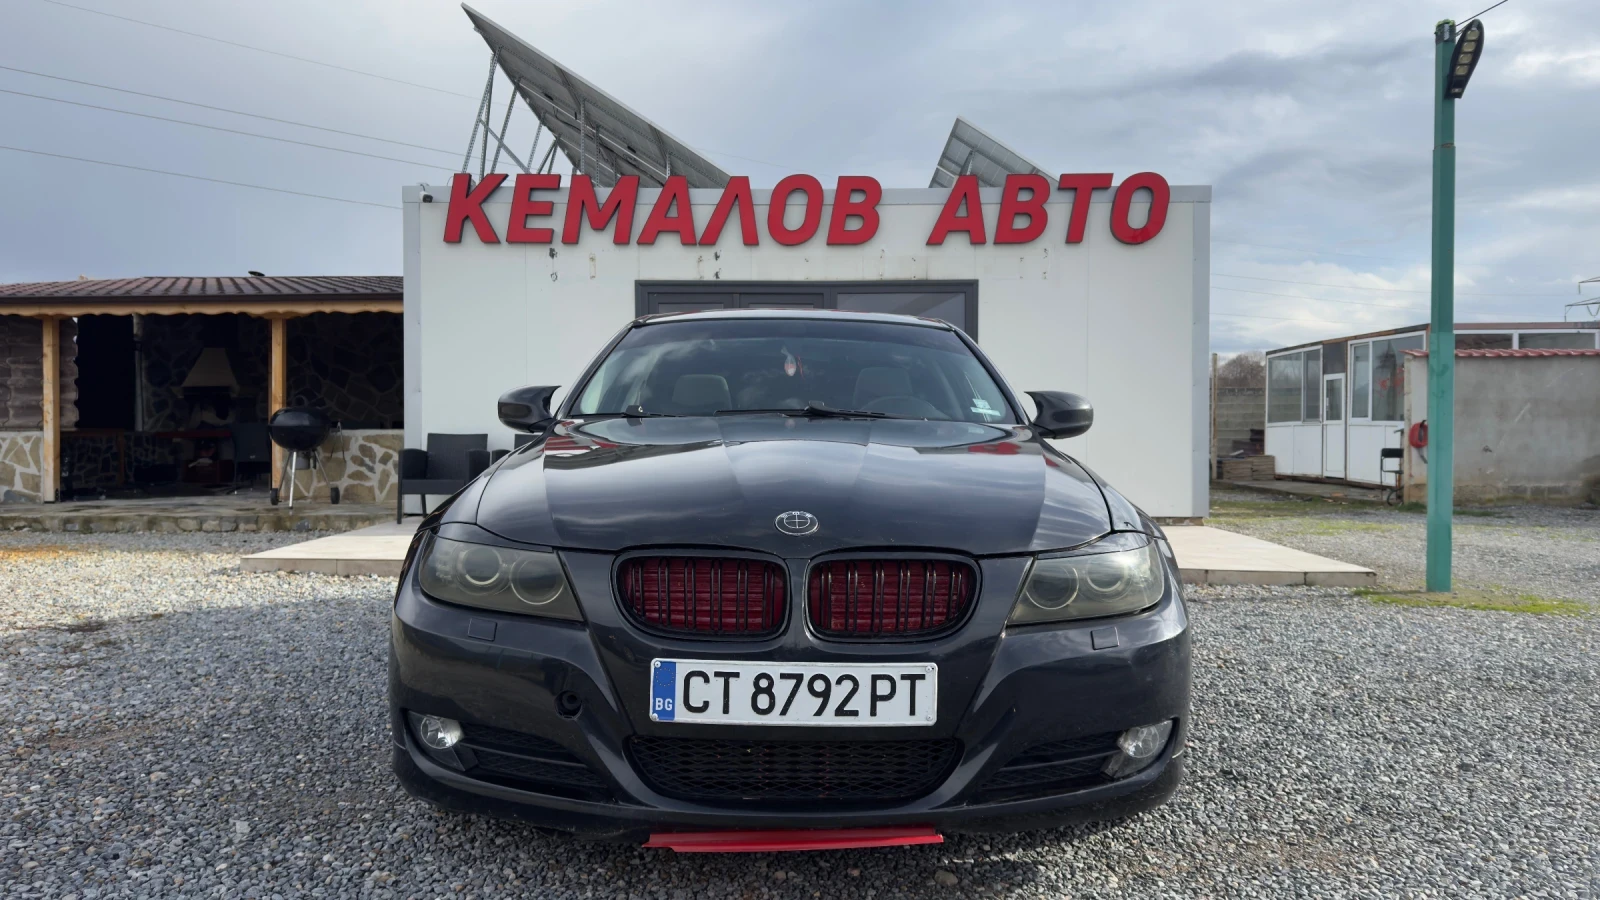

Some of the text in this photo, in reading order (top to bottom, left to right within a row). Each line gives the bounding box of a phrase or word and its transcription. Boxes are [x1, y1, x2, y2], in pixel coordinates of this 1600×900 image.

[443, 172, 1170, 246] КЕМАЛОВ АВТО
[655, 698, 673, 711] BG
[750, 672, 860, 716] 8792
